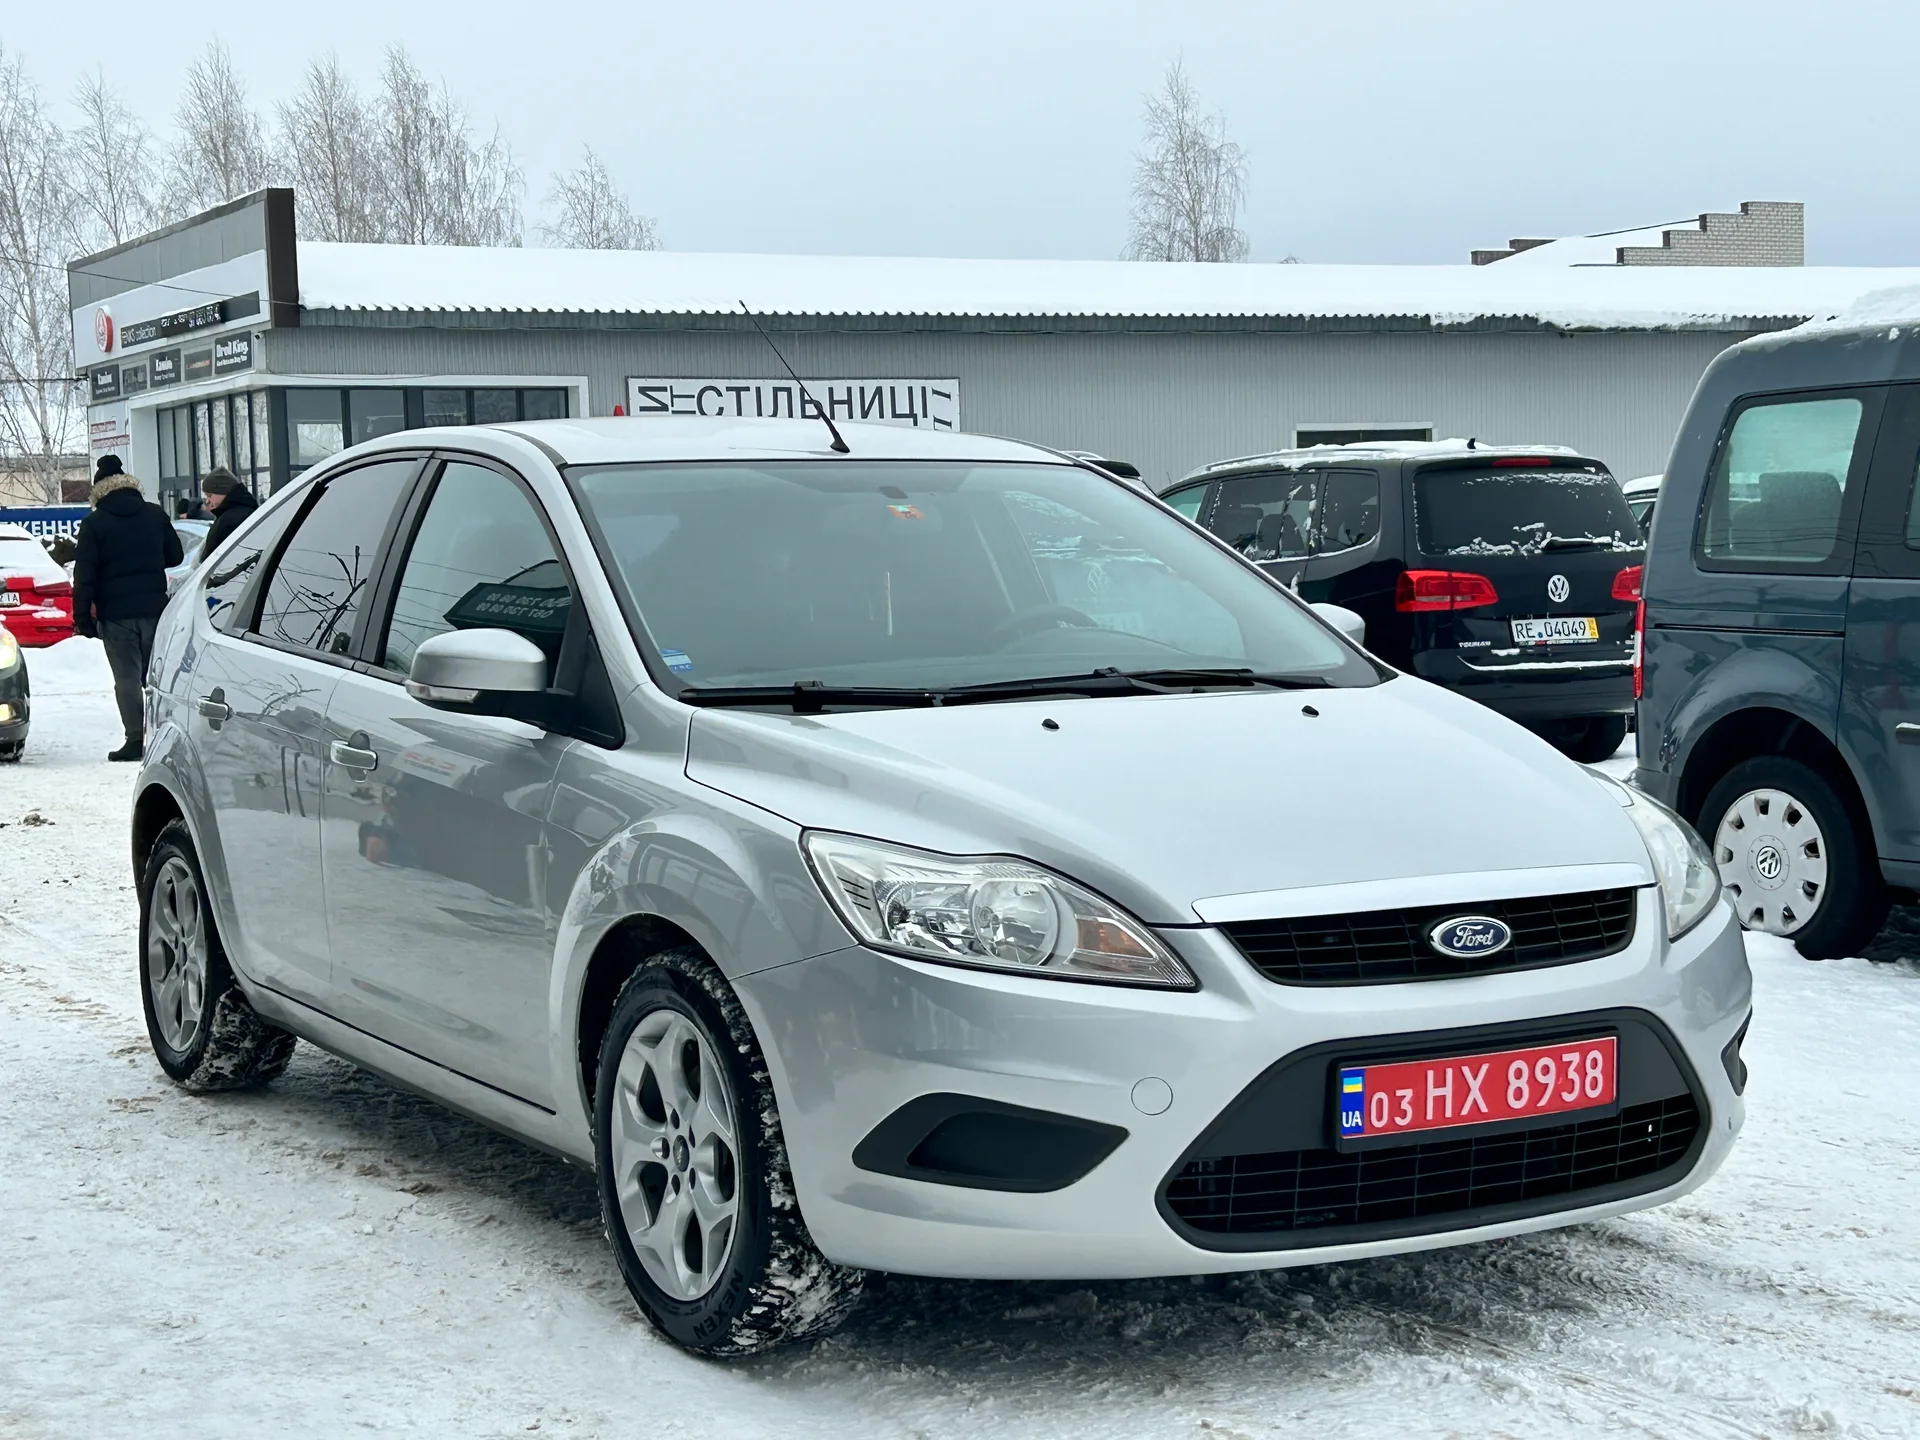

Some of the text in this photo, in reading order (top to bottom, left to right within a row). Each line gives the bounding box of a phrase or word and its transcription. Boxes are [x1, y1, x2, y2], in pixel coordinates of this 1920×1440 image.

[696, 385, 928, 427] СТІЛЬНИЦІ
[1545, 620, 1587, 638] 04049
[1453, 925, 1494, 948] Ford
[1370, 1050, 1603, 1128] 03 HX 8938
[1342, 1110, 1362, 1128] UA
[693, 1268, 743, 1339] NEXEN
